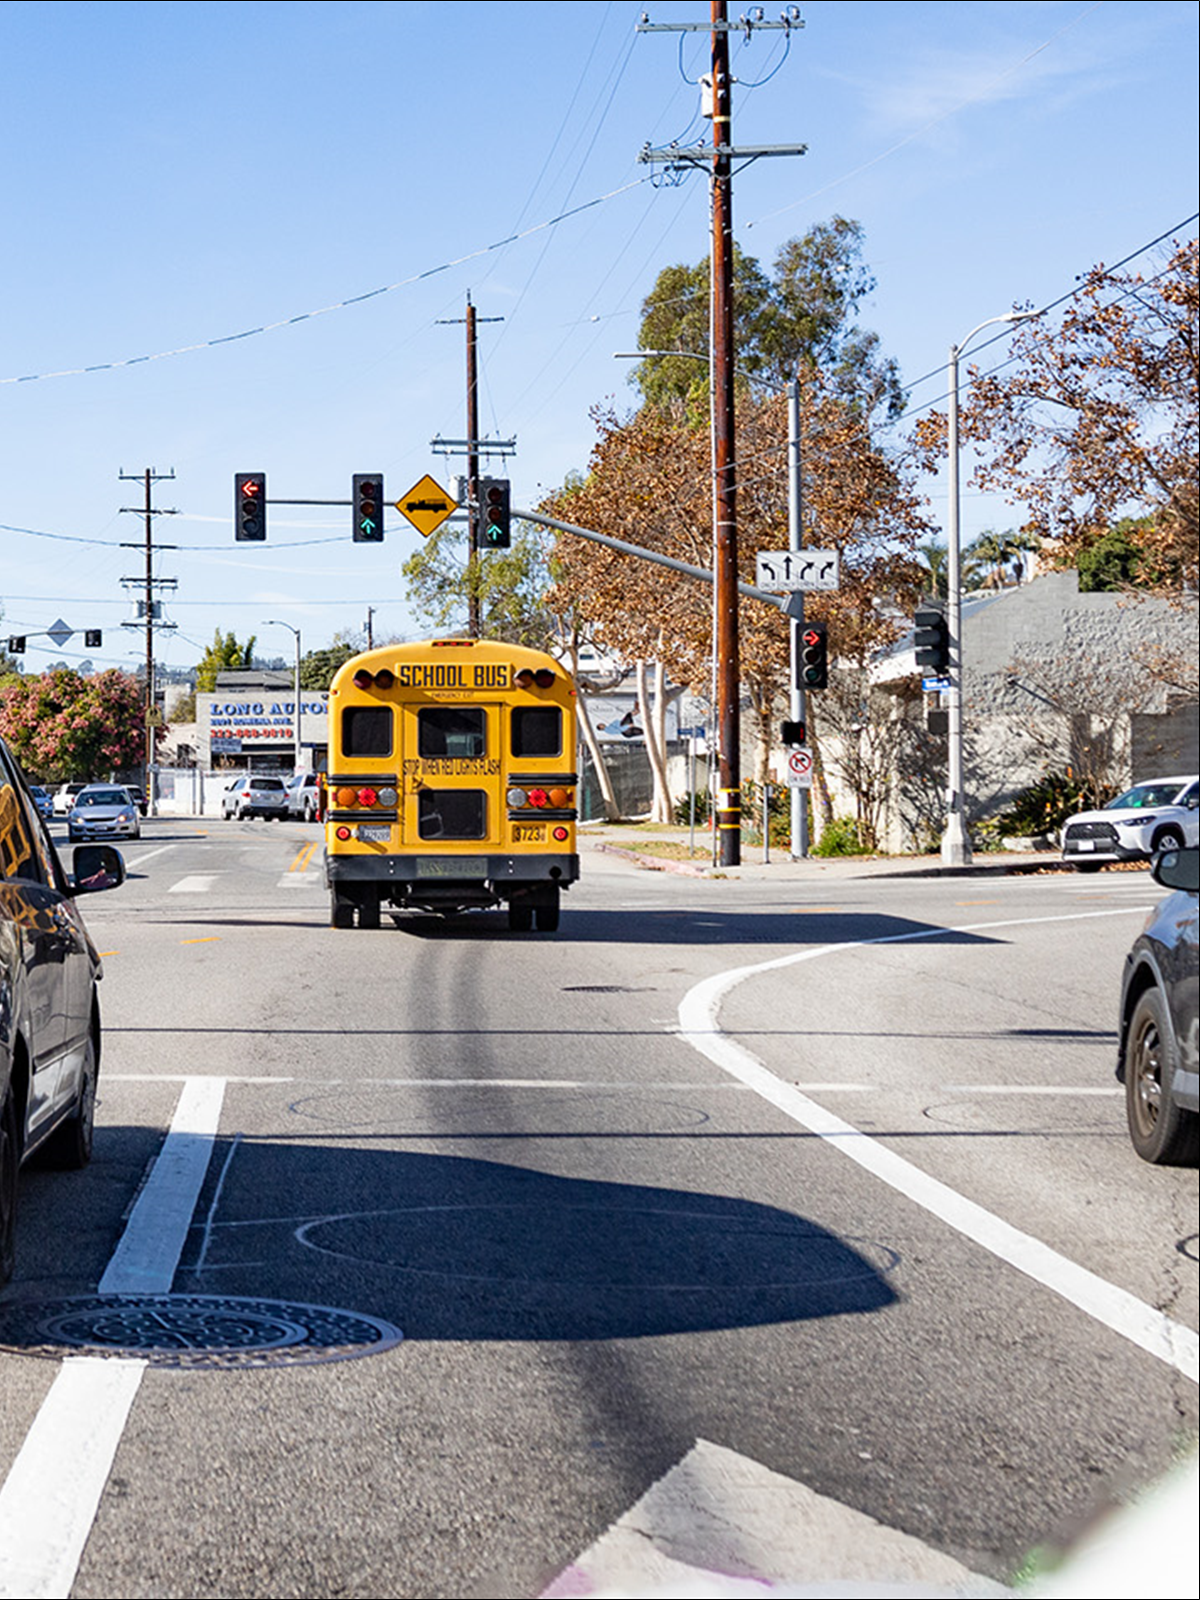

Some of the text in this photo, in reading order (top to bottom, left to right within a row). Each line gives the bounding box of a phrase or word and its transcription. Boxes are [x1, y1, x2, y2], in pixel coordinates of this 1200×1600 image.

[400, 665, 507, 687] SCHOOL BUS
[210, 702, 329, 716] LONG AUTO
[403, 759, 502, 776] STOP WHEN RED LIGHTS FLASH
